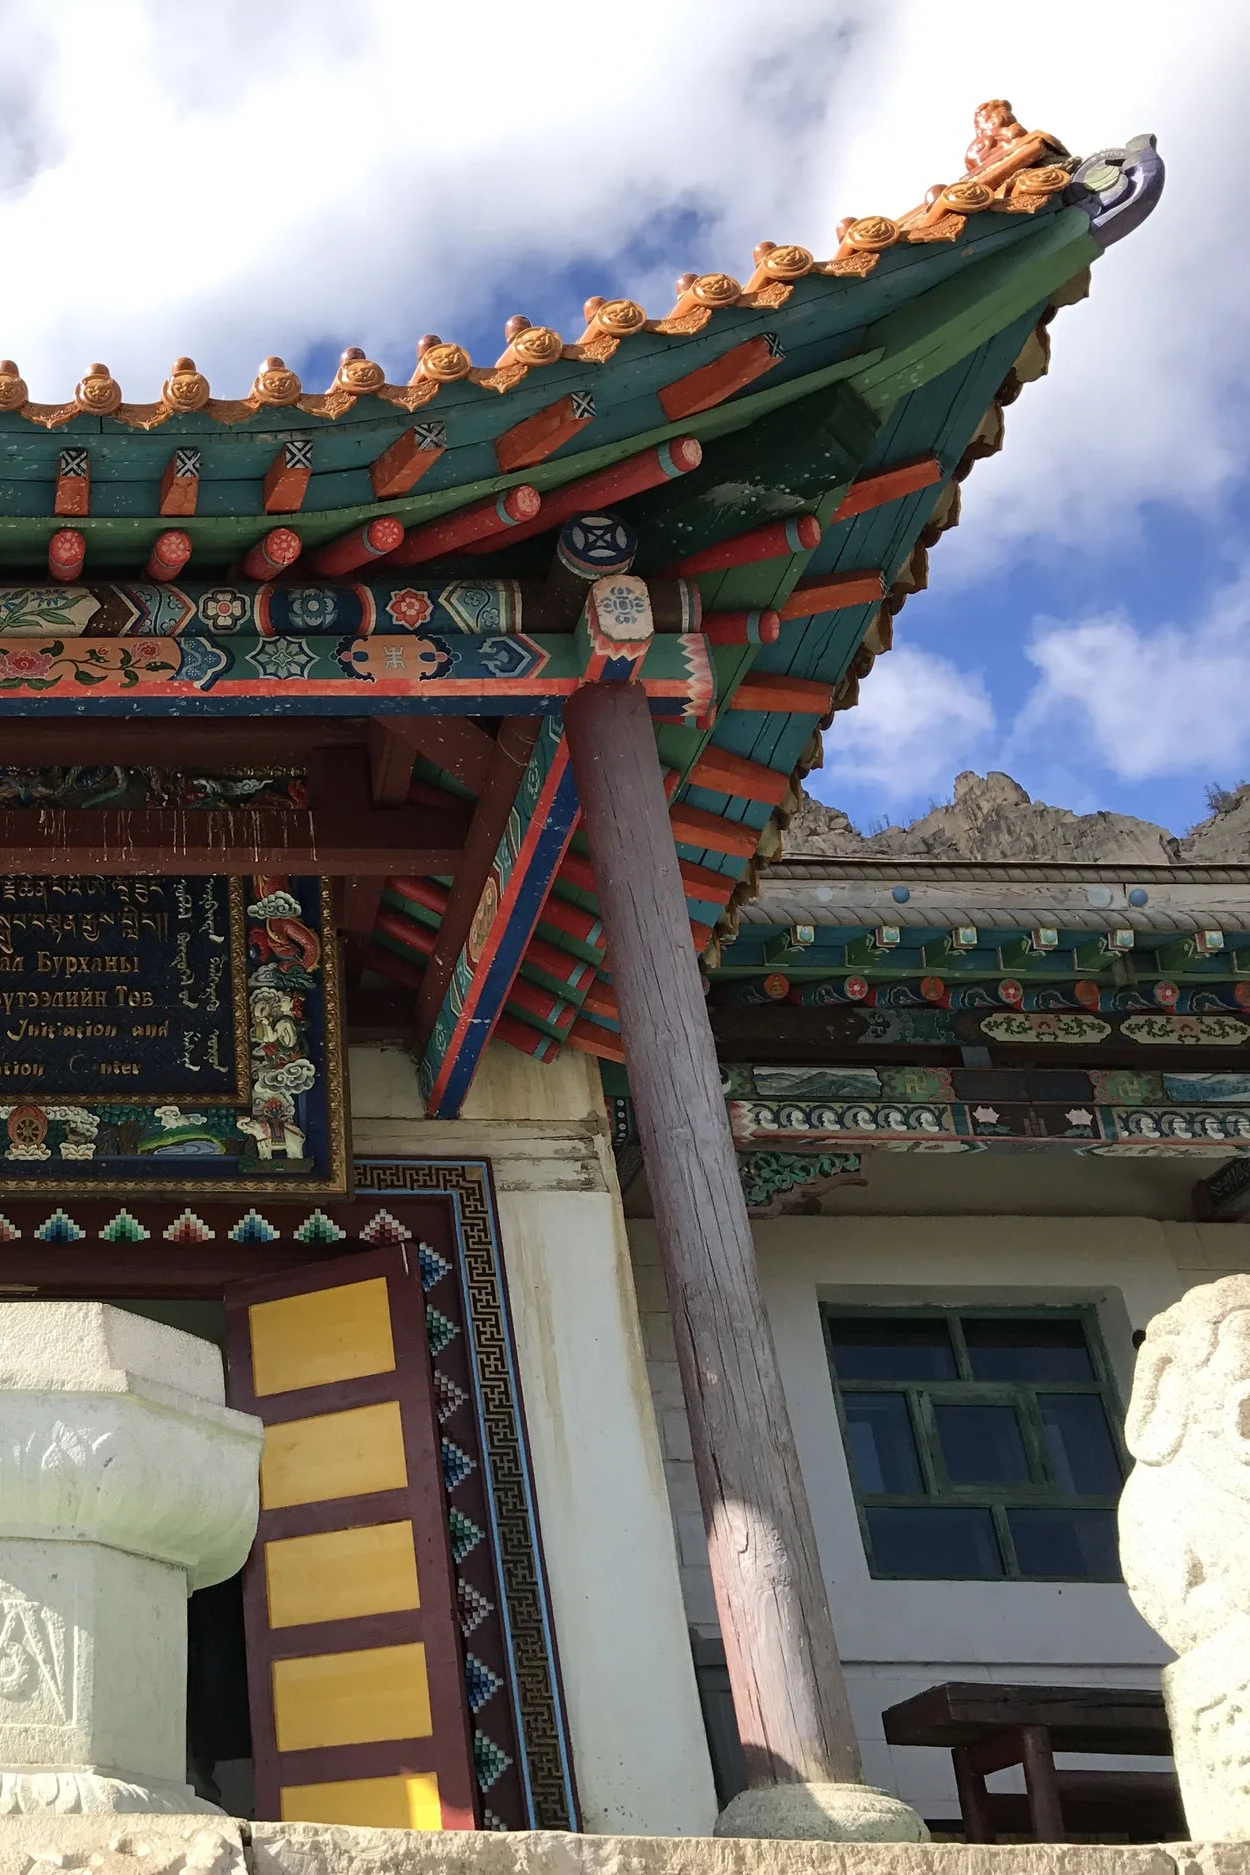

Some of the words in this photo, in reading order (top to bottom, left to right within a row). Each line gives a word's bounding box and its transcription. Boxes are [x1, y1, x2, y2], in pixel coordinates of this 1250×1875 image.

[36, 951, 141, 978] Бурханы
[114, 985, 155, 1008] Төв
[6, 1018, 118, 1041] Initation
[131, 1019, 170, 1038] and
[69, 1053, 142, 1076] Cnter
